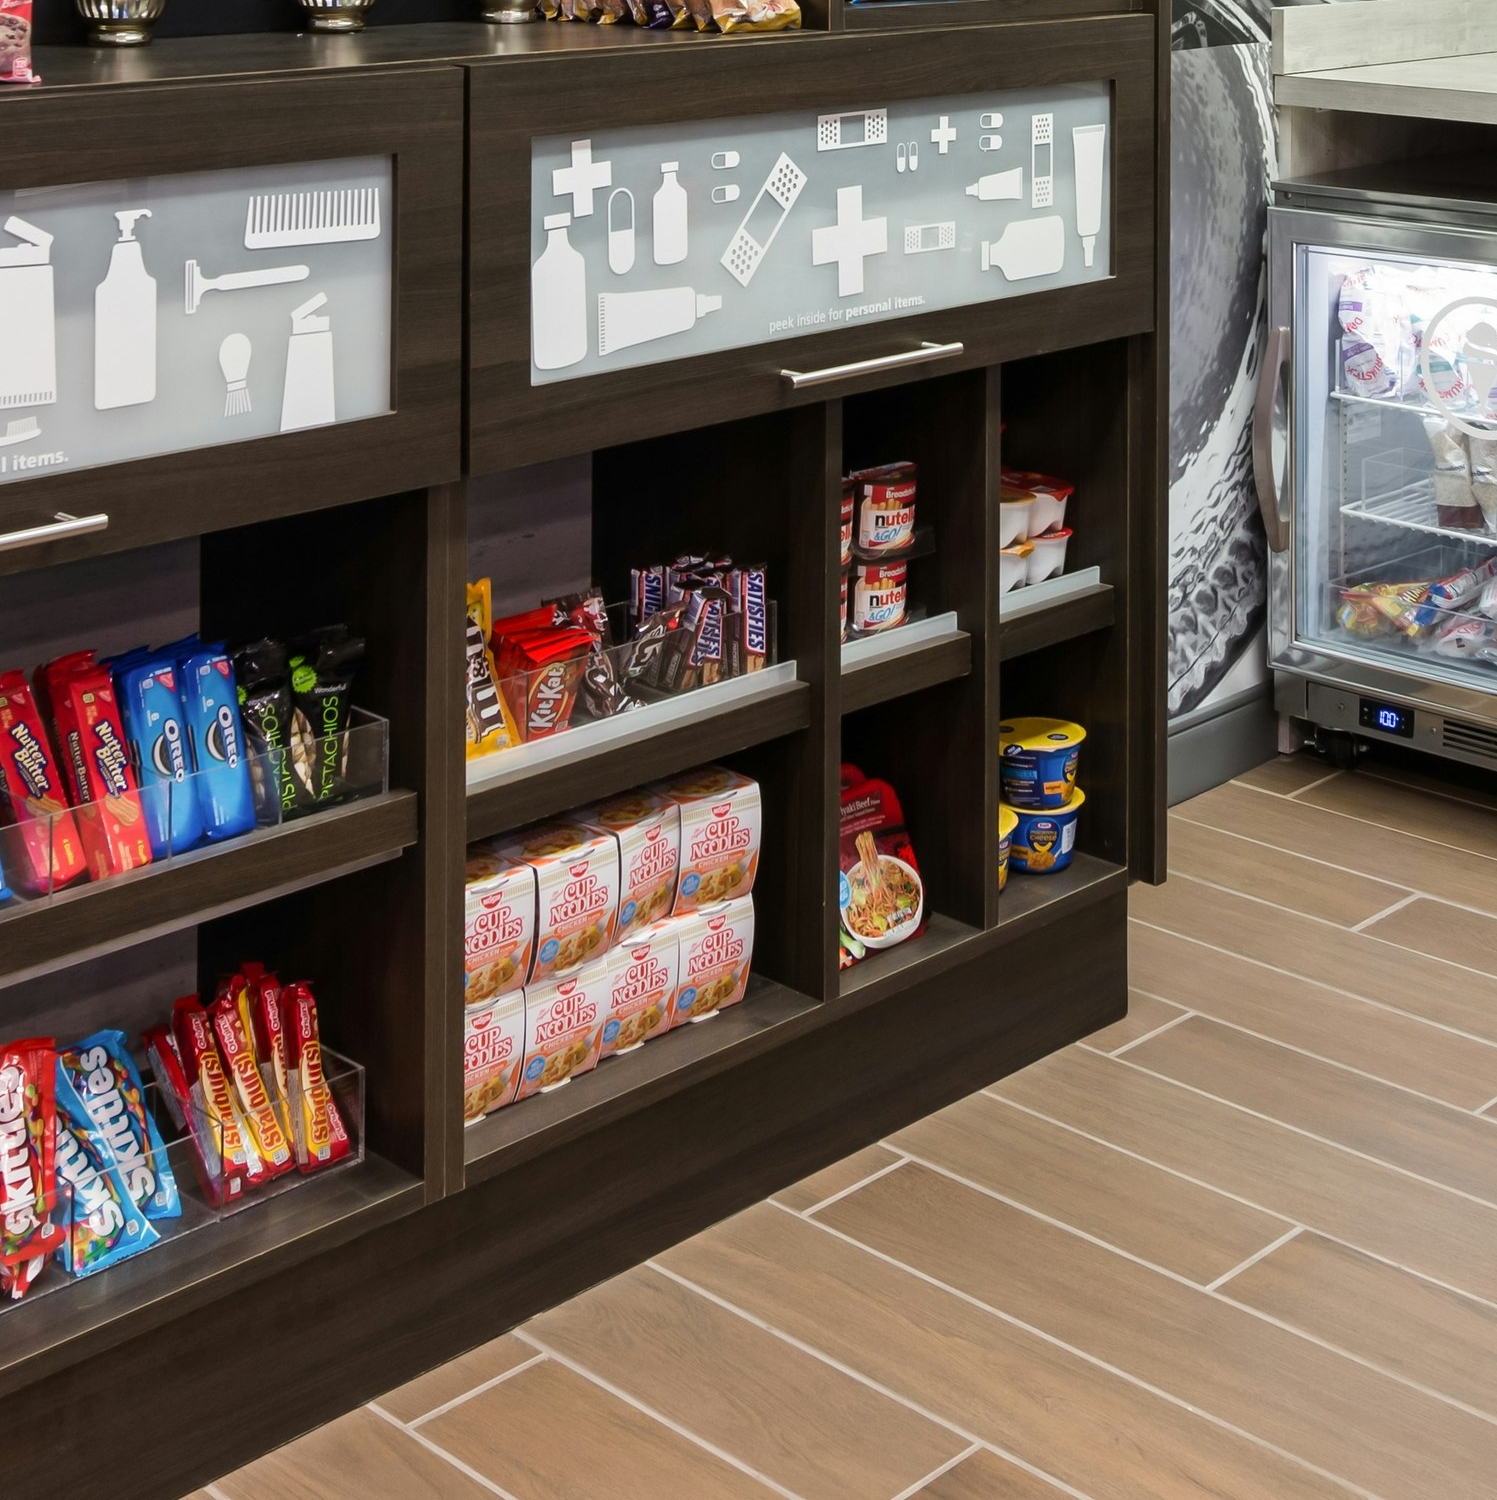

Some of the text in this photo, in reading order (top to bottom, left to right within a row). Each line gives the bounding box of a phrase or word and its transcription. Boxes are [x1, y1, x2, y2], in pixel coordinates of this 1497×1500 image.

[769, 293, 925, 334] peek inside for personal items.
[12, 449, 69, 472] items.
[314, 684, 347, 694] Wonderful
[11, 723, 47, 765] Nutter
[95, 721, 127, 765] Nutter
[165, 719, 185, 782] OREO
[218, 705, 237, 768] OREO
[14, 747, 49, 789] Butter
[95, 746, 128, 790] Butter
[690, 827, 750, 862] NOODLES
[705, 817, 739, 841] CUP
[628, 848, 676, 890] NOODLES
[641, 838, 668, 865] CUP
[549, 885, 609, 927] NOODLES
[564, 875, 597, 901] CUP
[474, 906, 512, 934] CUP
[467, 948, 500, 966] CHICKEN
[688, 938, 744, 977] NOODLES
[701, 928, 734, 954] CUP
[611, 968, 669, 1009] NOODLES
[625, 958, 659, 985] CUP
[265, 990, 281, 1031] Original
[536, 1003, 597, 1045] NOODLES
[550, 992, 586, 1020] CUP
[219, 1013, 238, 1054] Original
[232, 1052, 286, 1151] Starburst
[302, 1041, 330, 1143] Starburst
[327, 1103, 348, 1141] Original
